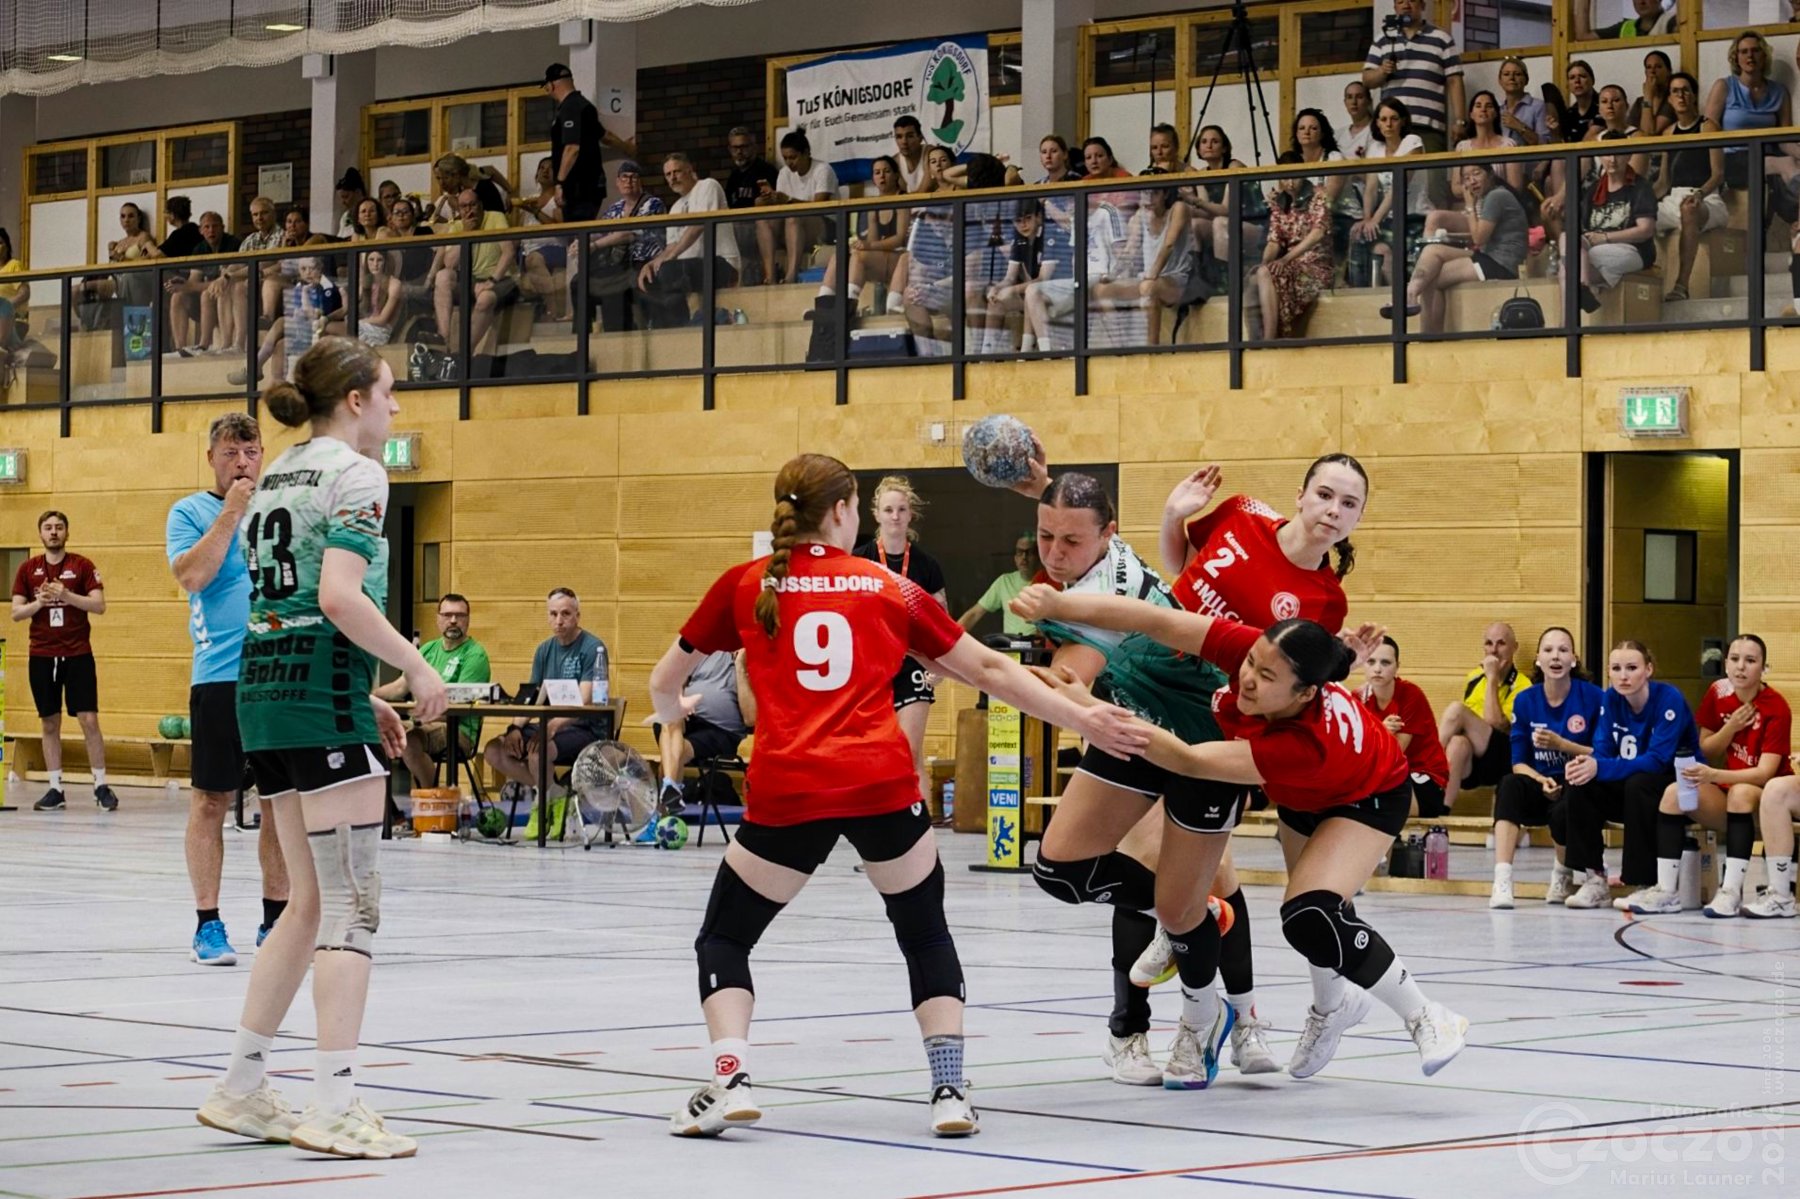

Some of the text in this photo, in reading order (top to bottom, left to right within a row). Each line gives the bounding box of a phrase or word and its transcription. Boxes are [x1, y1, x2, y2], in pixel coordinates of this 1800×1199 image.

[610, 97, 622, 113] C
[797, 77, 914, 117] TuS KÖNIGSDORF
[809, 118, 821, 130] für
[893, 102, 917, 117] stark
[247, 506, 298, 602] 13
[1203, 547, 1236, 579] 2
[793, 610, 854, 691] 9
[241, 688, 308, 703] USTOFFE
[989, 741, 1017, 750] opentext
[991, 792, 1018, 806] VENI
